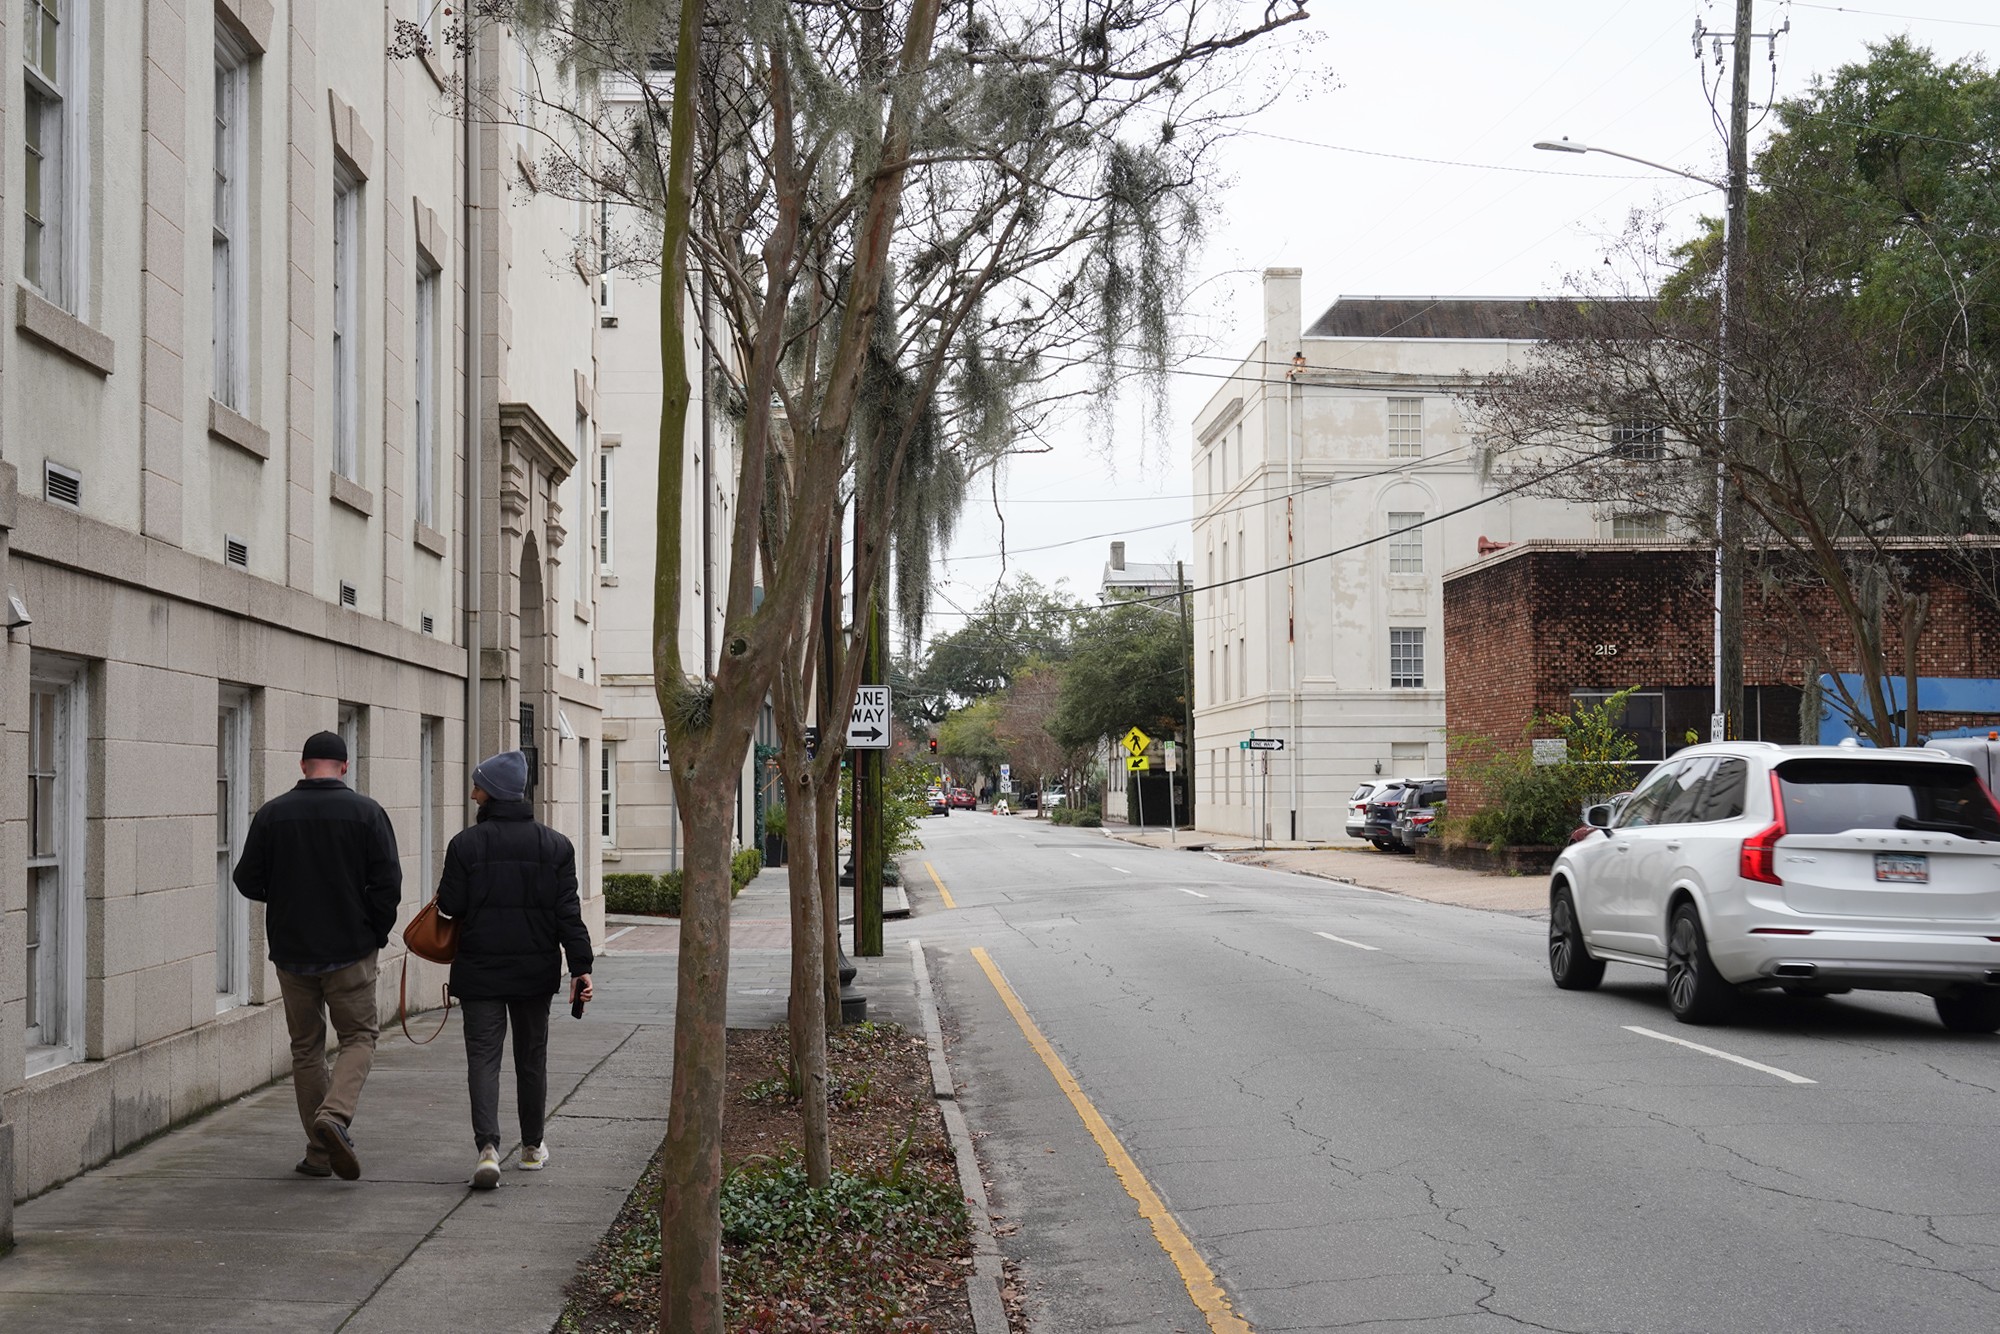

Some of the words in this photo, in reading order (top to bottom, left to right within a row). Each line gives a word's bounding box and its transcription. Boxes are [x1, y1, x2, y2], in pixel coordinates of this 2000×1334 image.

[1595, 644, 1617, 656] 215
[854, 691, 884, 706] ONE
[851, 708, 885, 723] WAY
[1712, 717, 1723, 729] ONE
[1856, 837, 1953, 847] VOLVO
